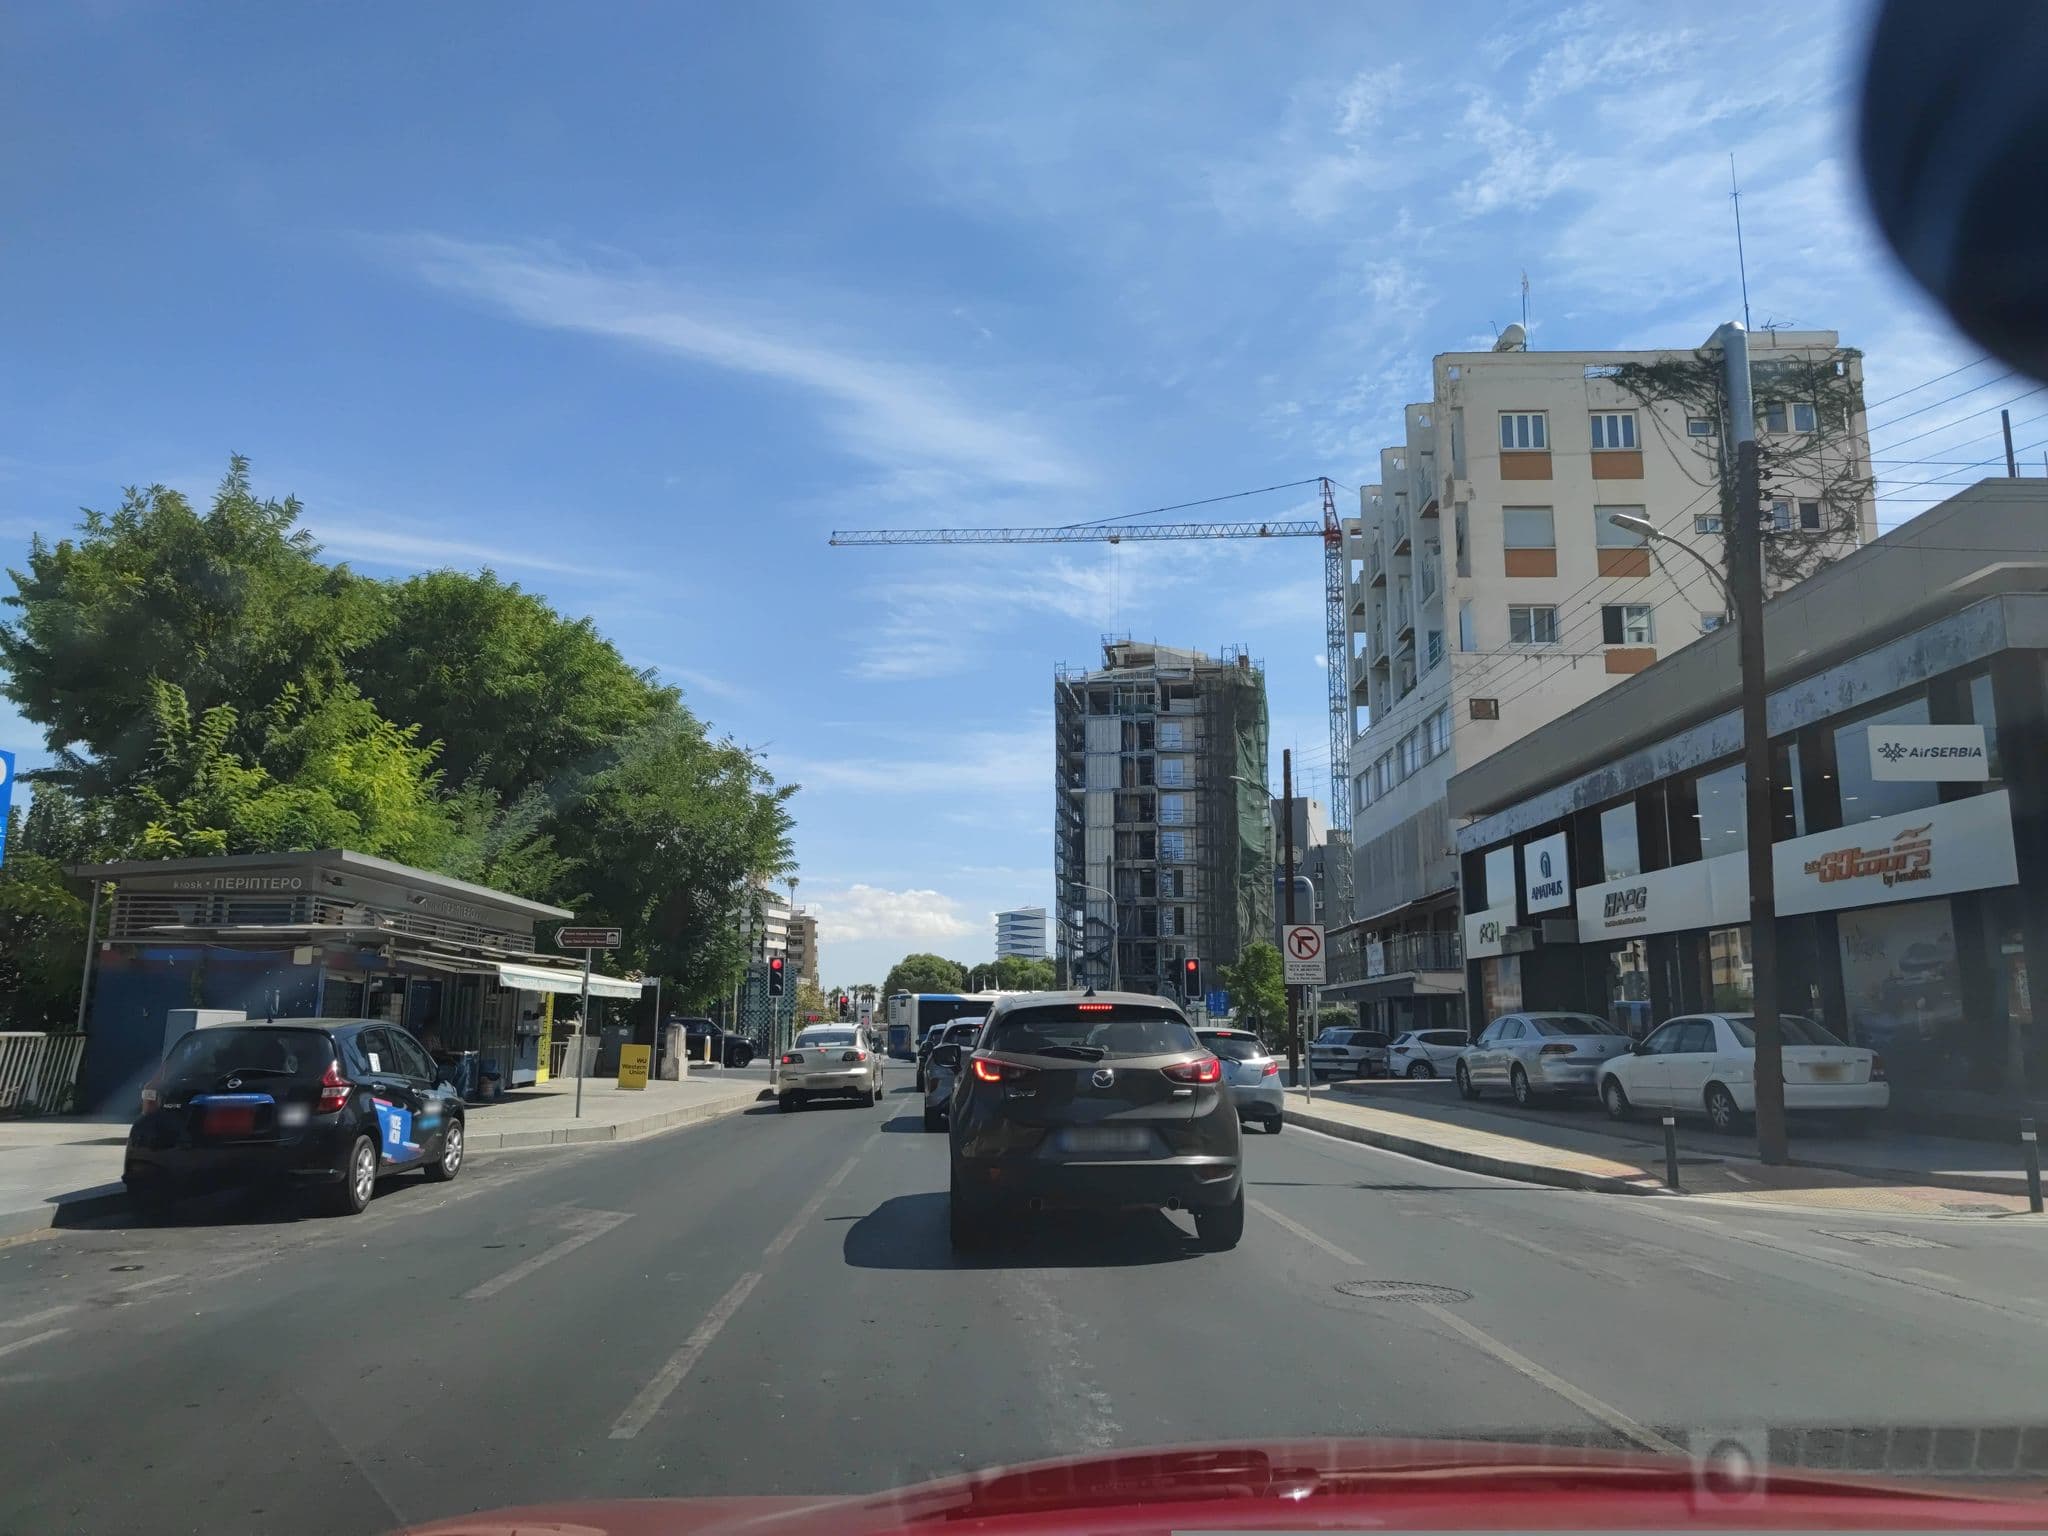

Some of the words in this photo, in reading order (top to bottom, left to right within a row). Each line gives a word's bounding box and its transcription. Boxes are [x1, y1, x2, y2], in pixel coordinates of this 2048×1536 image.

[1908, 746, 1982, 758] AirSERBIA
[214, 877, 302, 889] ΠΕΡΙΠΤΕΡΟ
[1531, 880, 1563, 901] AMATHUS
[1603, 886, 1648, 918] HAPG
